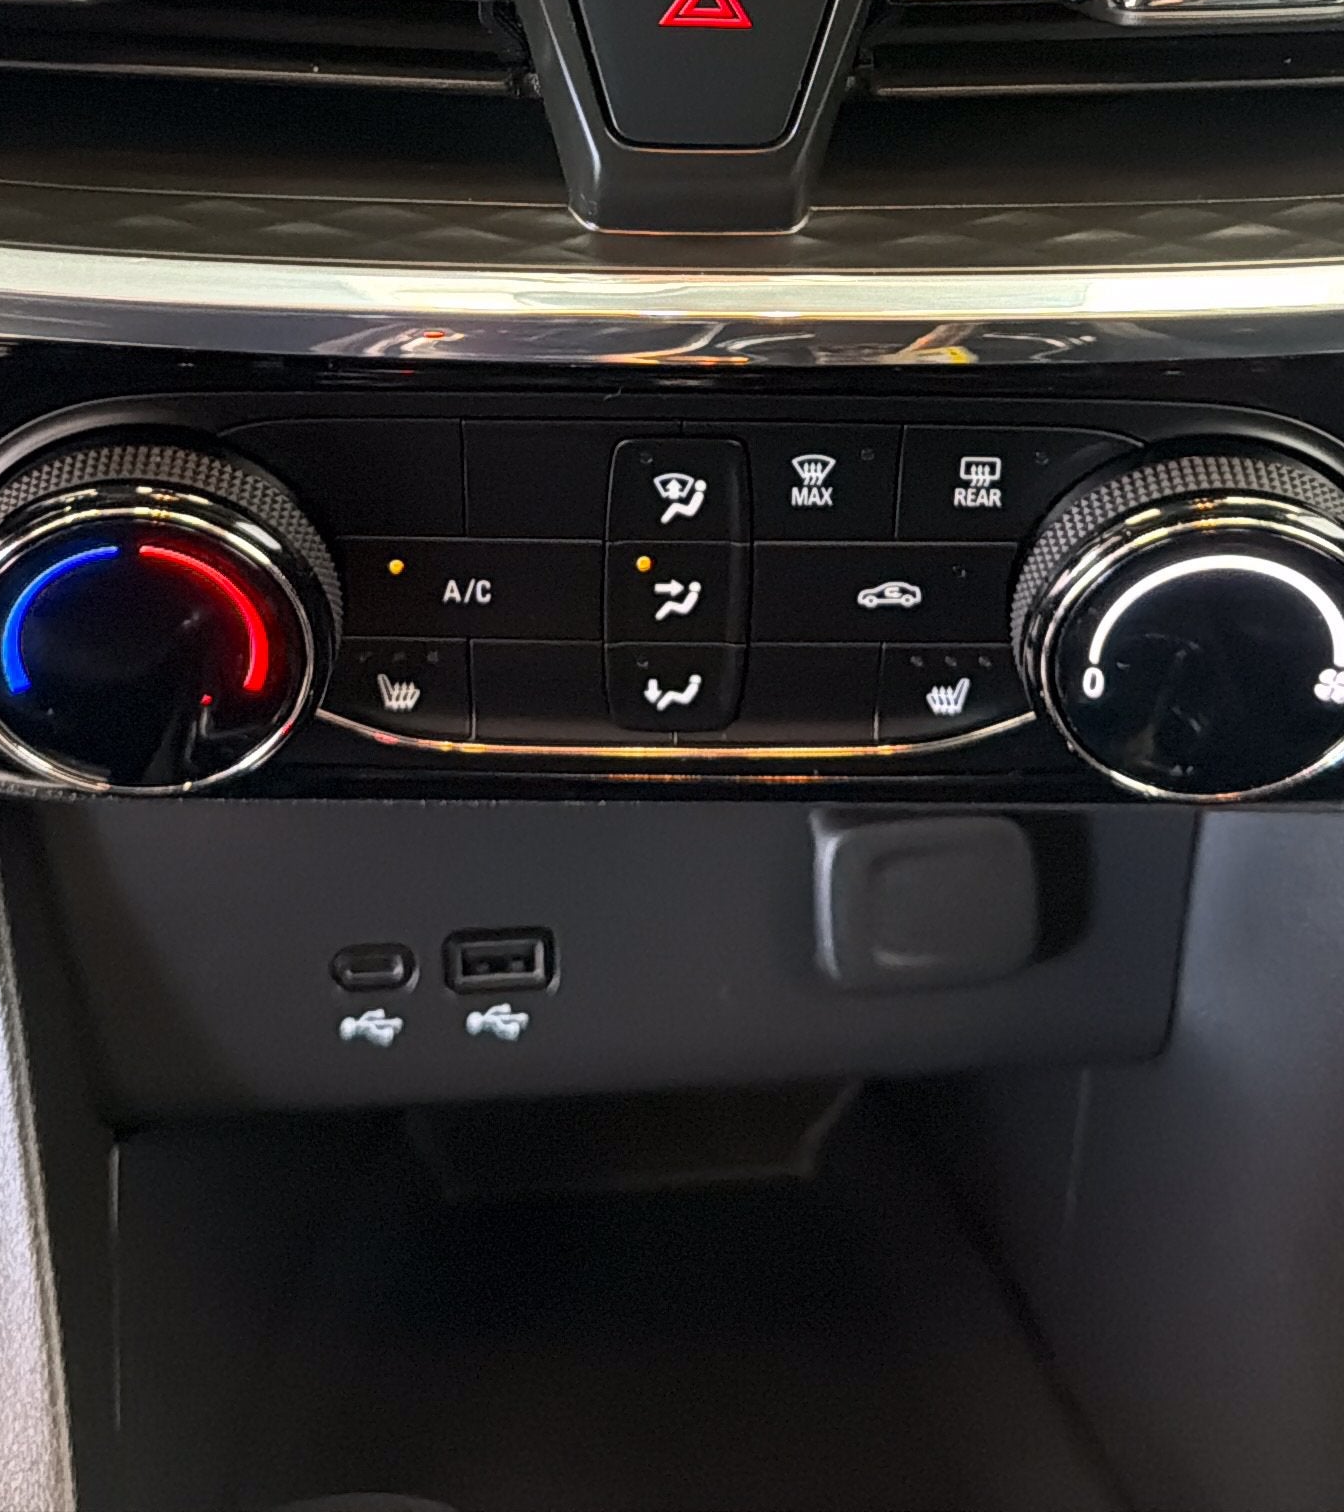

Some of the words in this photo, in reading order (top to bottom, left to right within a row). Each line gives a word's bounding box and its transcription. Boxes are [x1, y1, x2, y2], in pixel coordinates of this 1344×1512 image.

[791, 487, 834, 508] MAX
[954, 487, 1002, 508] REAR
[442, 579, 493, 605] A/C
